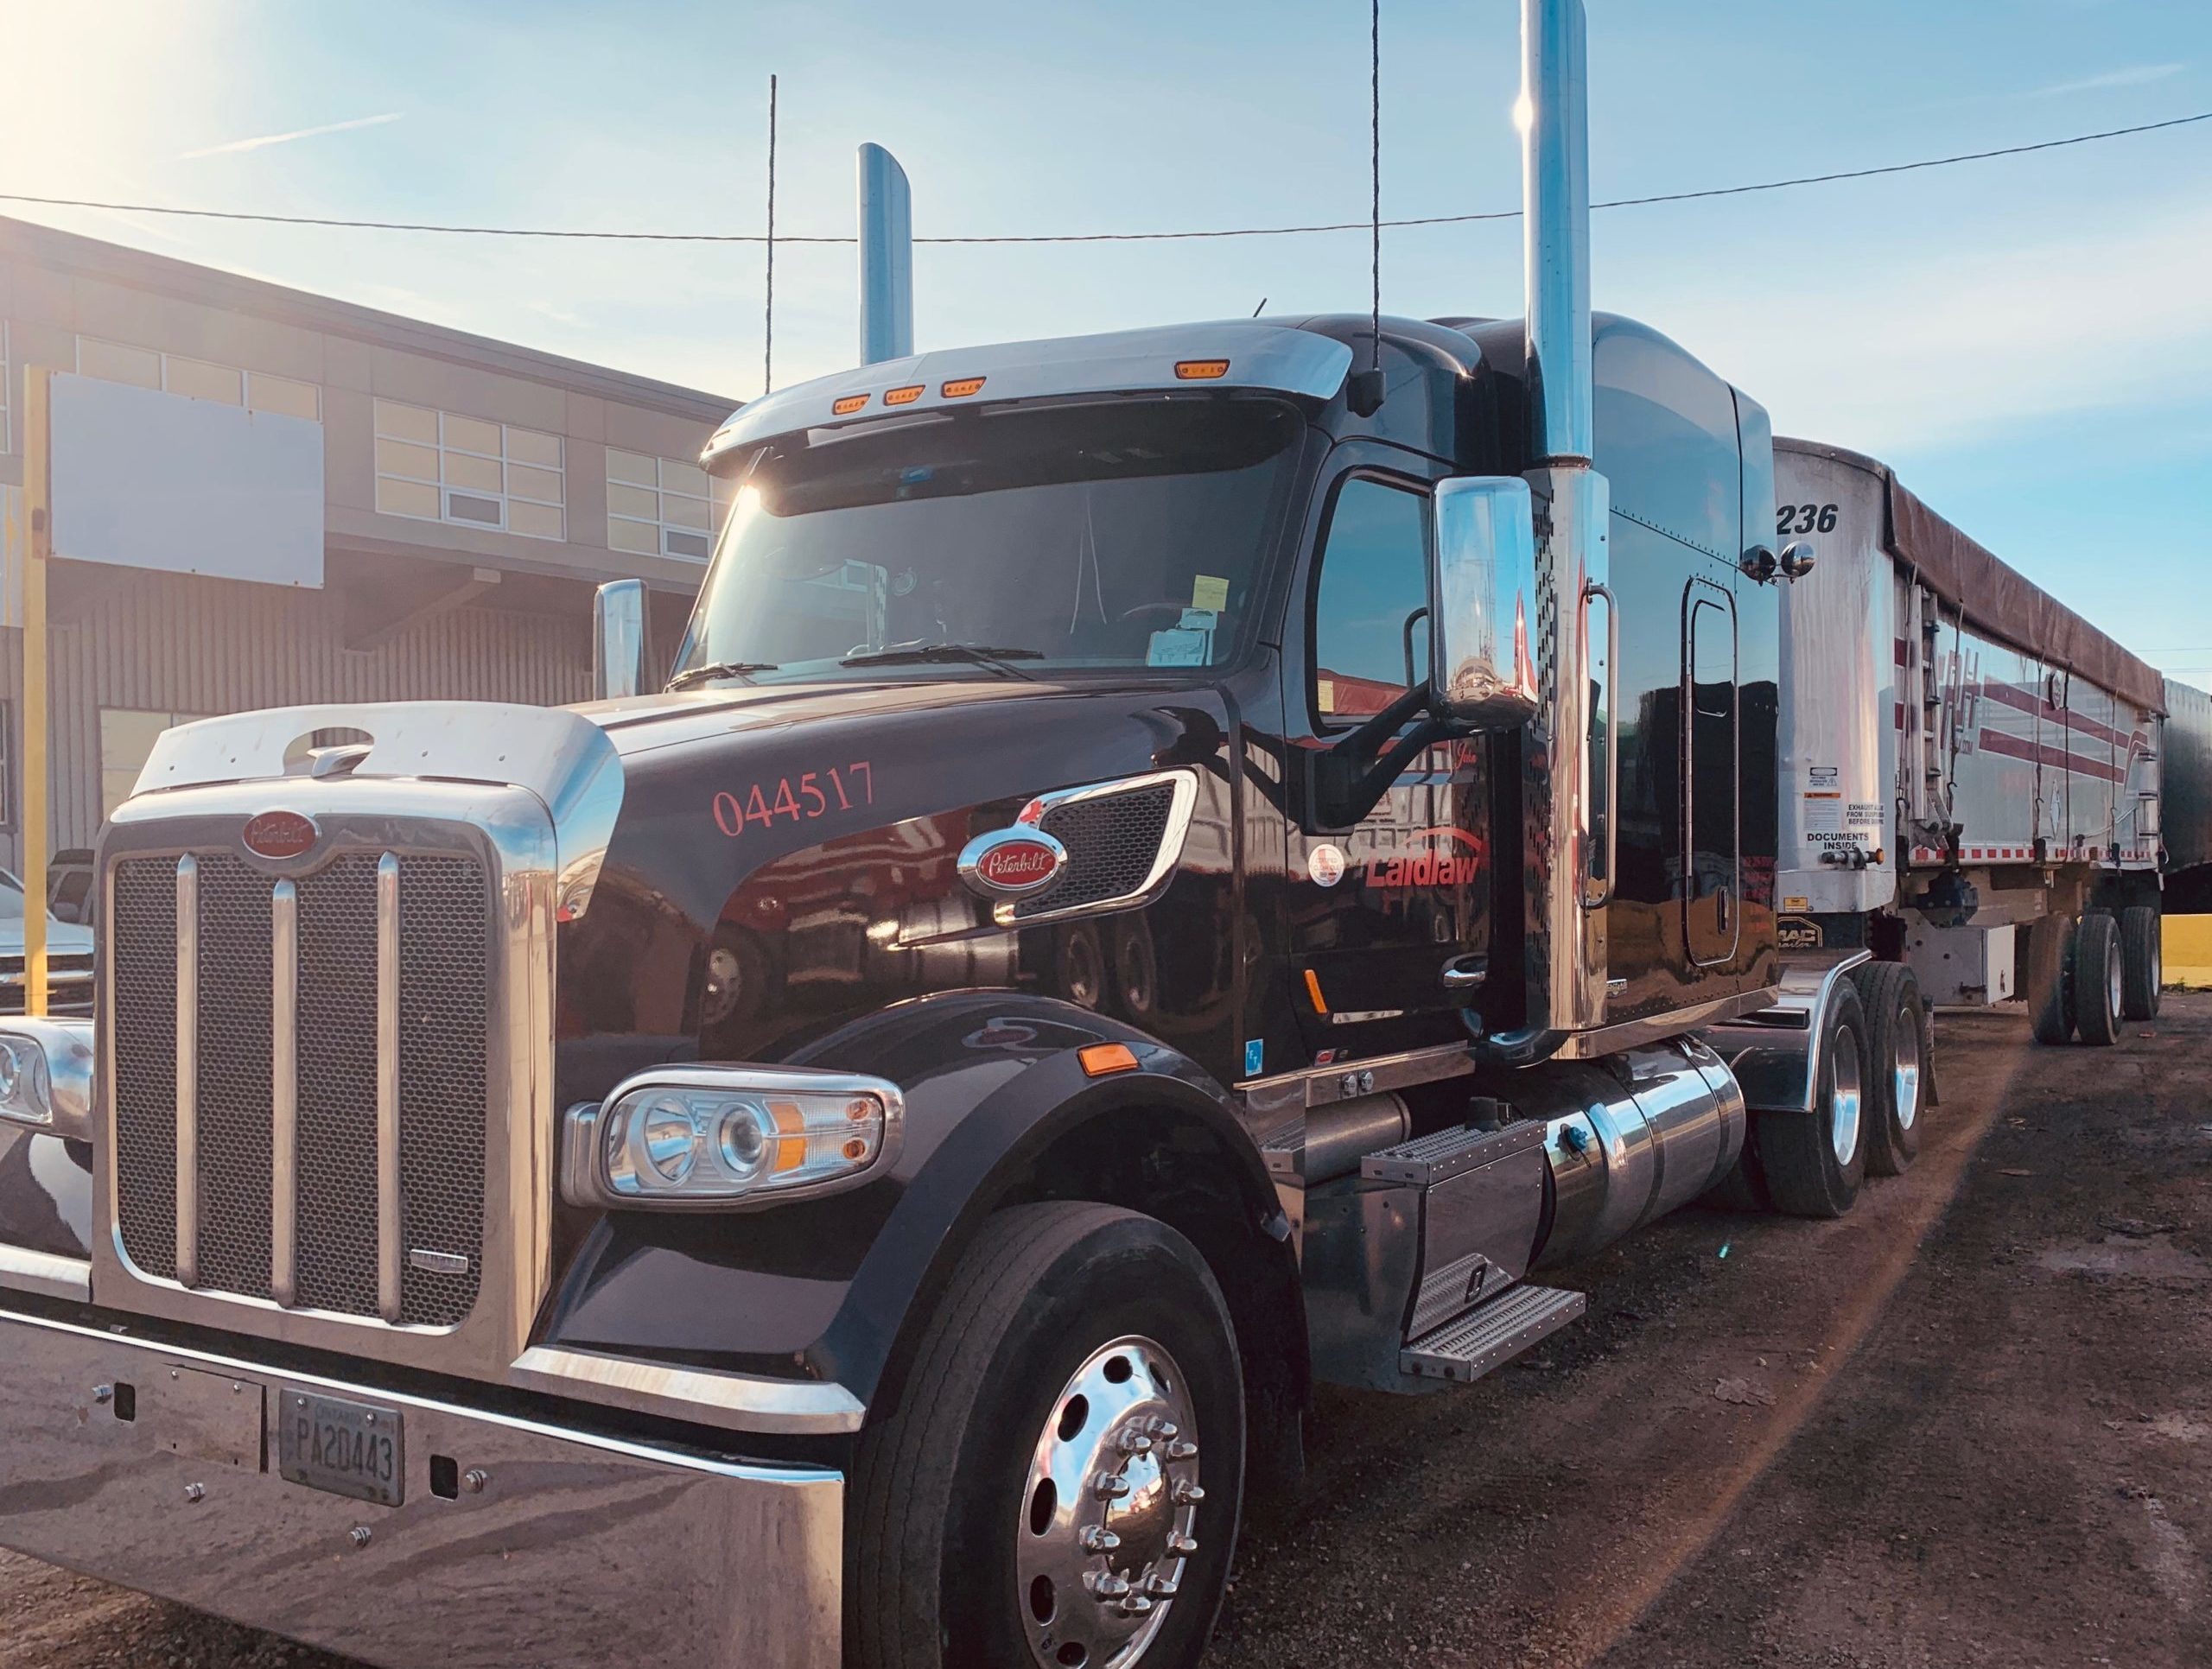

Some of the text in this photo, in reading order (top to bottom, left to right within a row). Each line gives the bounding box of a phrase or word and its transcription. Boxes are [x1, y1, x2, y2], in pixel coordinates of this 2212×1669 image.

[1777, 504, 1839, 536] 236
[713, 761, 873, 837] 044517
[1808, 833, 1869, 841] DOCUMENTS
[1824, 841, 1857, 850] INSIDE
[988, 852, 1050, 877] Peterbilt
[1365, 846, 1478, 887] Laidlaw
[297, 1417, 392, 1482] PA20443
